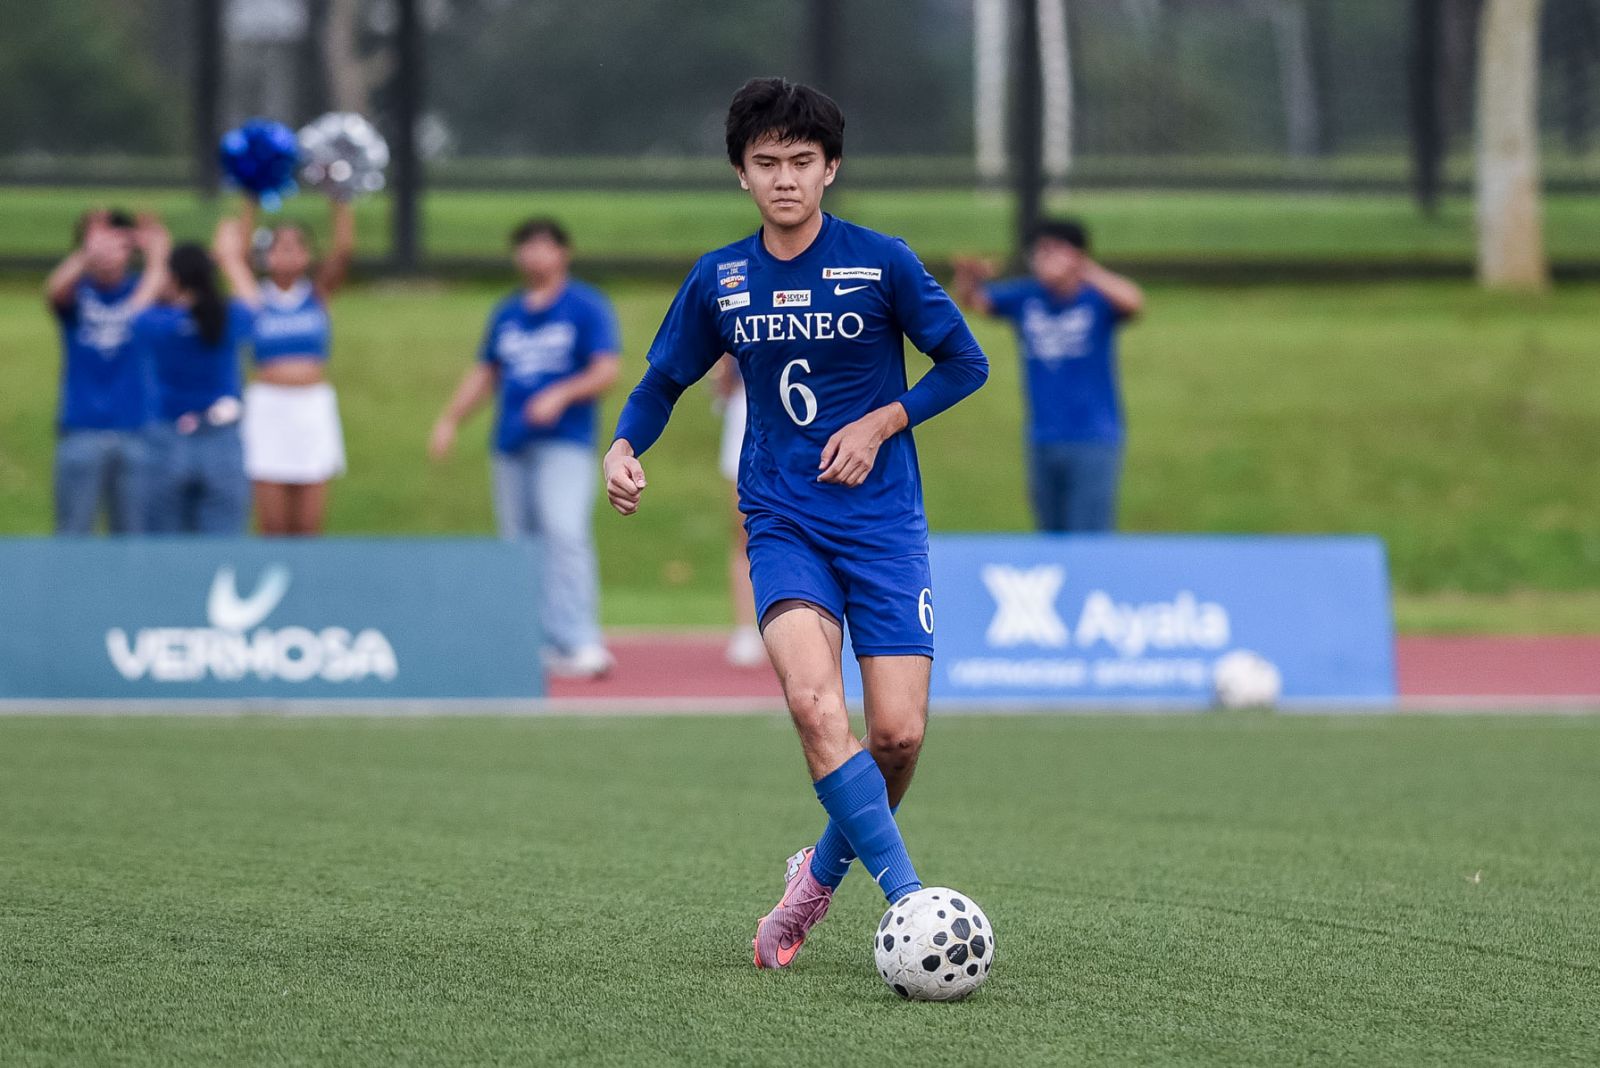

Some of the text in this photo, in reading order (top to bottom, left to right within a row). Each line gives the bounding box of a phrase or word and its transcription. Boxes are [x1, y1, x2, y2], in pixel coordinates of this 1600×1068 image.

[734, 311, 864, 343] ATENEO
[779, 358, 817, 426] 6
[918, 587, 933, 634] 6
[1074, 590, 1230, 657] Ayala
[105, 626, 398, 682] VERMOSA
